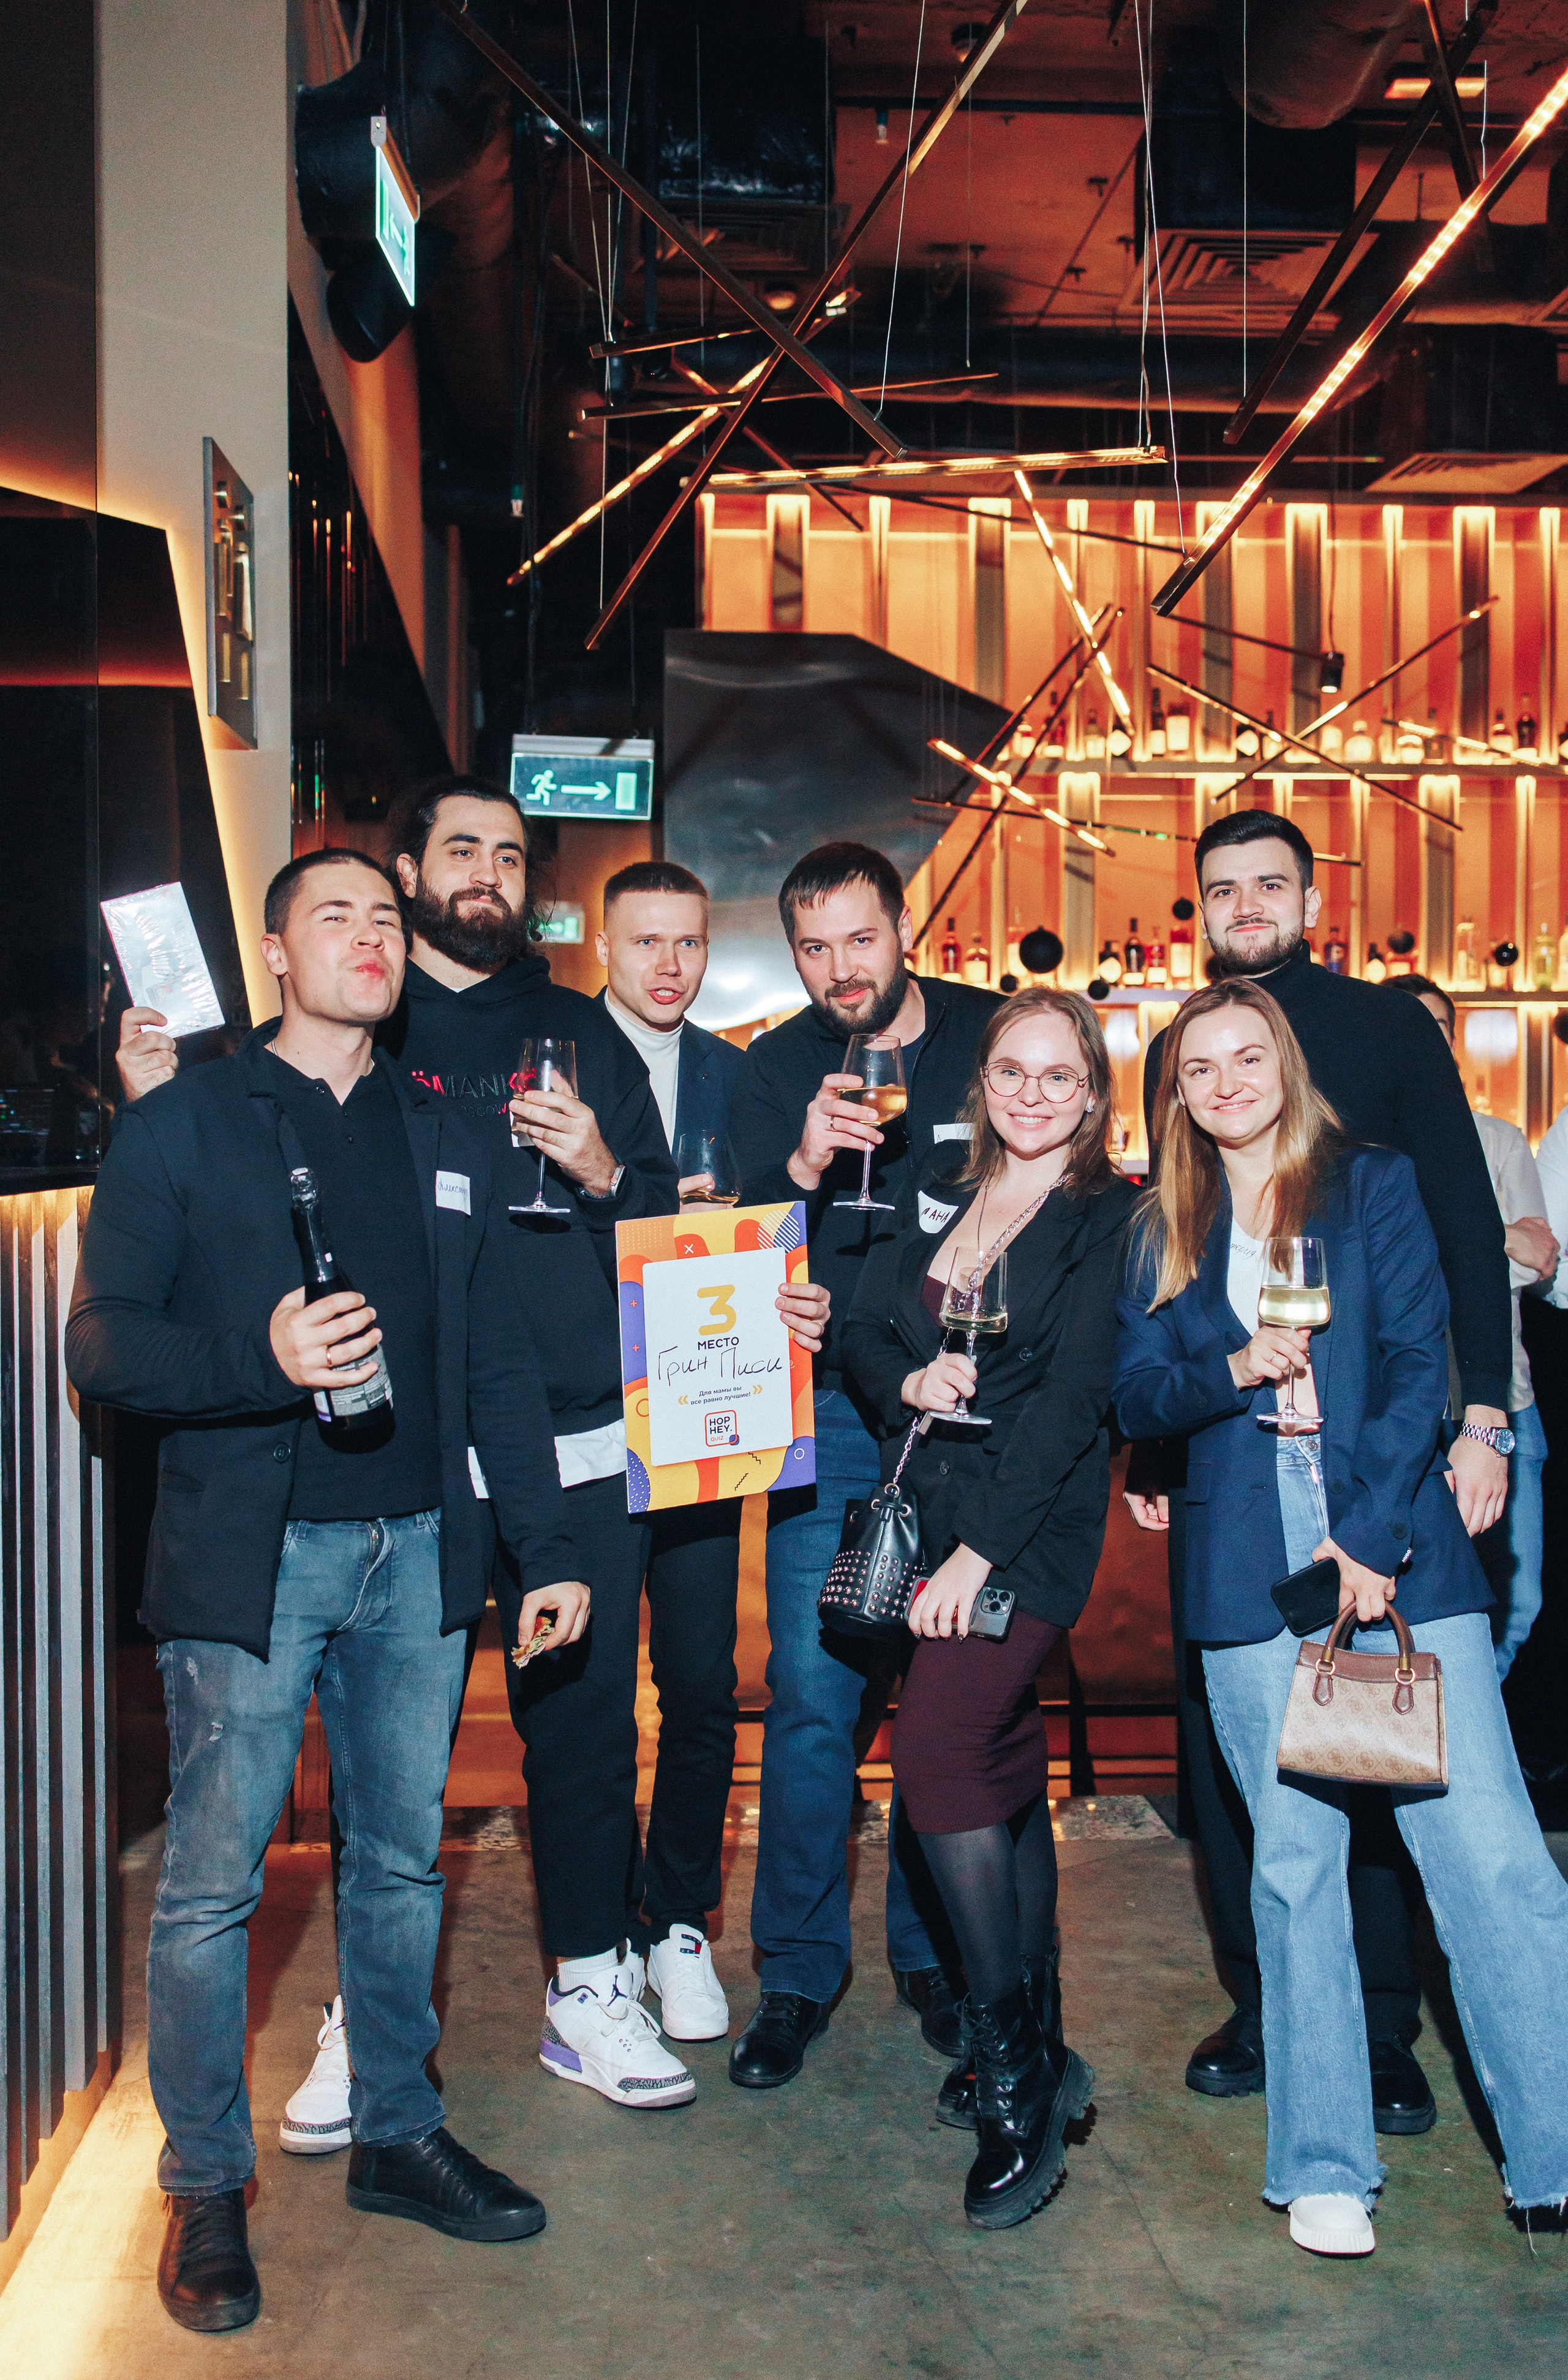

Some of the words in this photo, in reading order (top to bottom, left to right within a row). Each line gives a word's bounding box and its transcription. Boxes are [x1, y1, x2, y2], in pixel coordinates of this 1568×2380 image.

[697, 1284, 736, 1335] 3
[698, 1337, 739, 1350] МЕСТО
[658, 1346, 707, 1386] Грин
[720, 1347, 782, 1380] Писи
[724, 1392, 751, 1400] лучшие!
[709, 1416, 730, 1426] HOP
[710, 1424, 733, 1434] HEY.
[1401, 1549, 1411, 1563] HUGO
